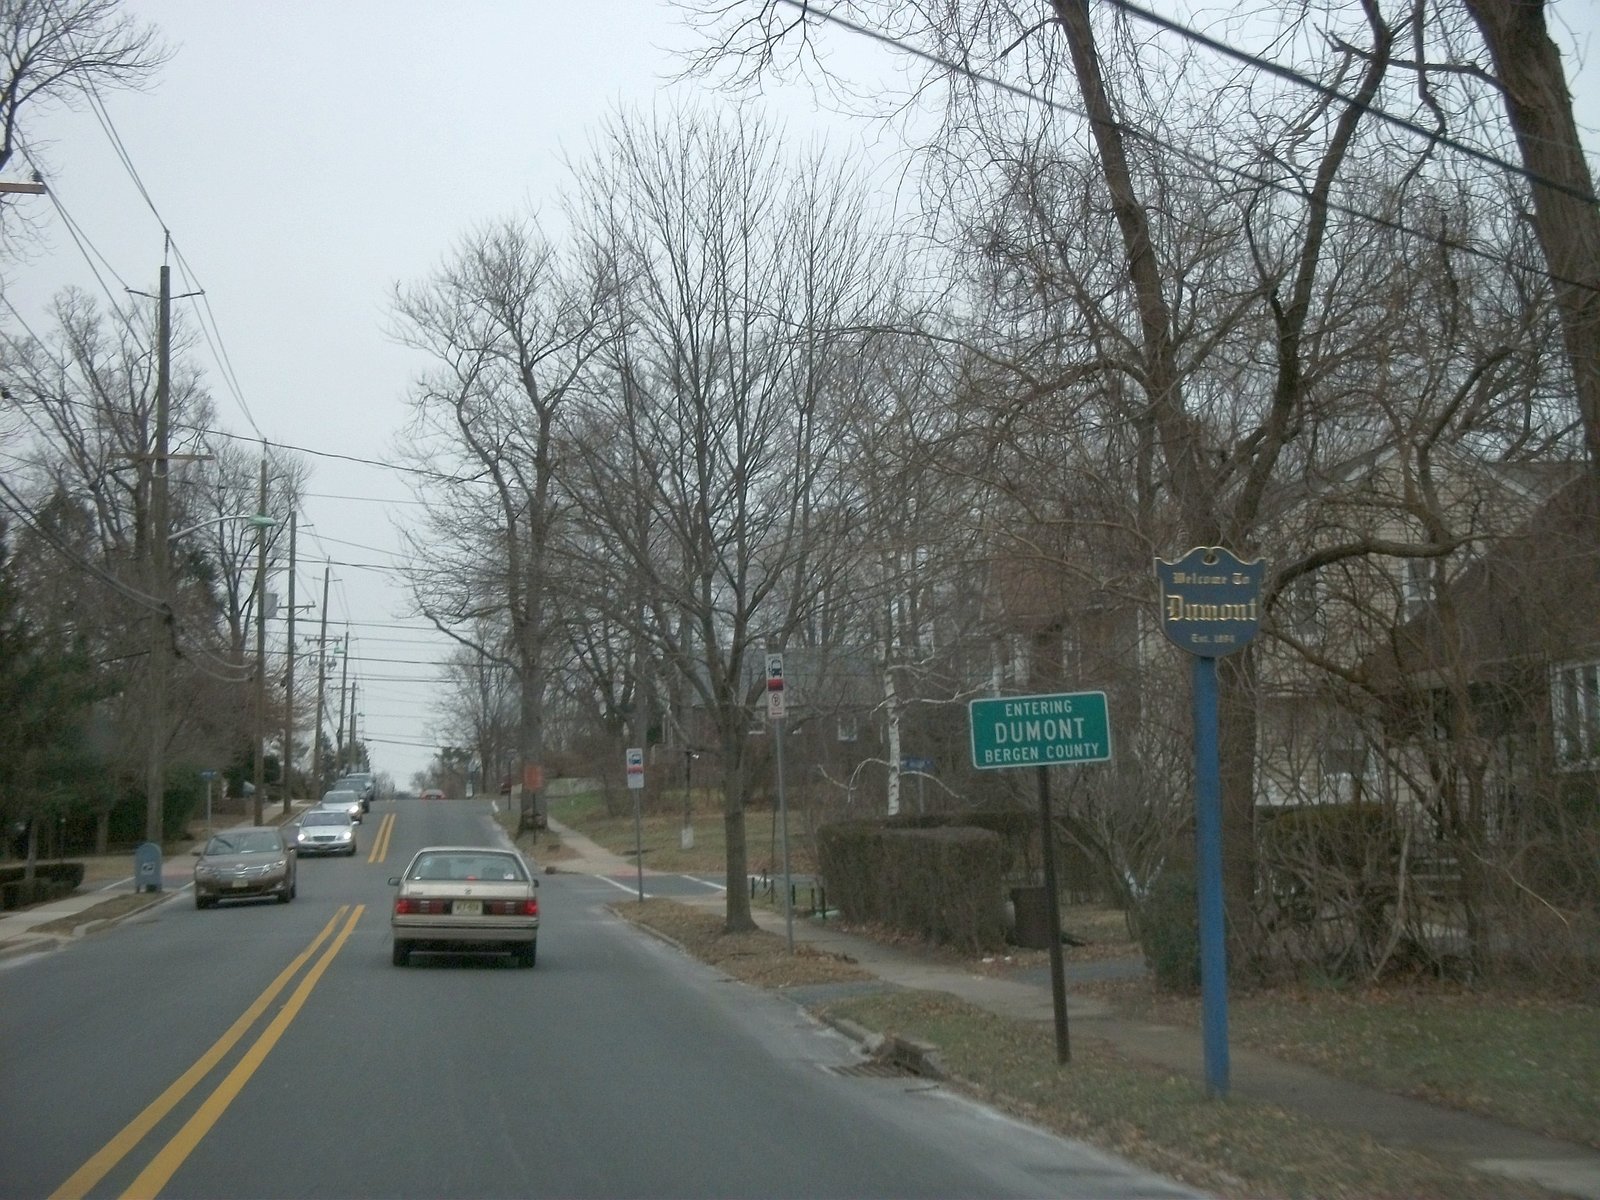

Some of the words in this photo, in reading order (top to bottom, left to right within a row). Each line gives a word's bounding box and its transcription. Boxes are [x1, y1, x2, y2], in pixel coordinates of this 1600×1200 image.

[1172, 572, 1228, 584] Welcome
[1232, 572, 1250, 585] To
[1166, 594, 1258, 621] Dumont
[1005, 700, 1072, 717] ENTERING
[995, 717, 1085, 743] DUMONT
[985, 746, 1039, 763] BERGEN
[1046, 742, 1100, 759] COUNTY
